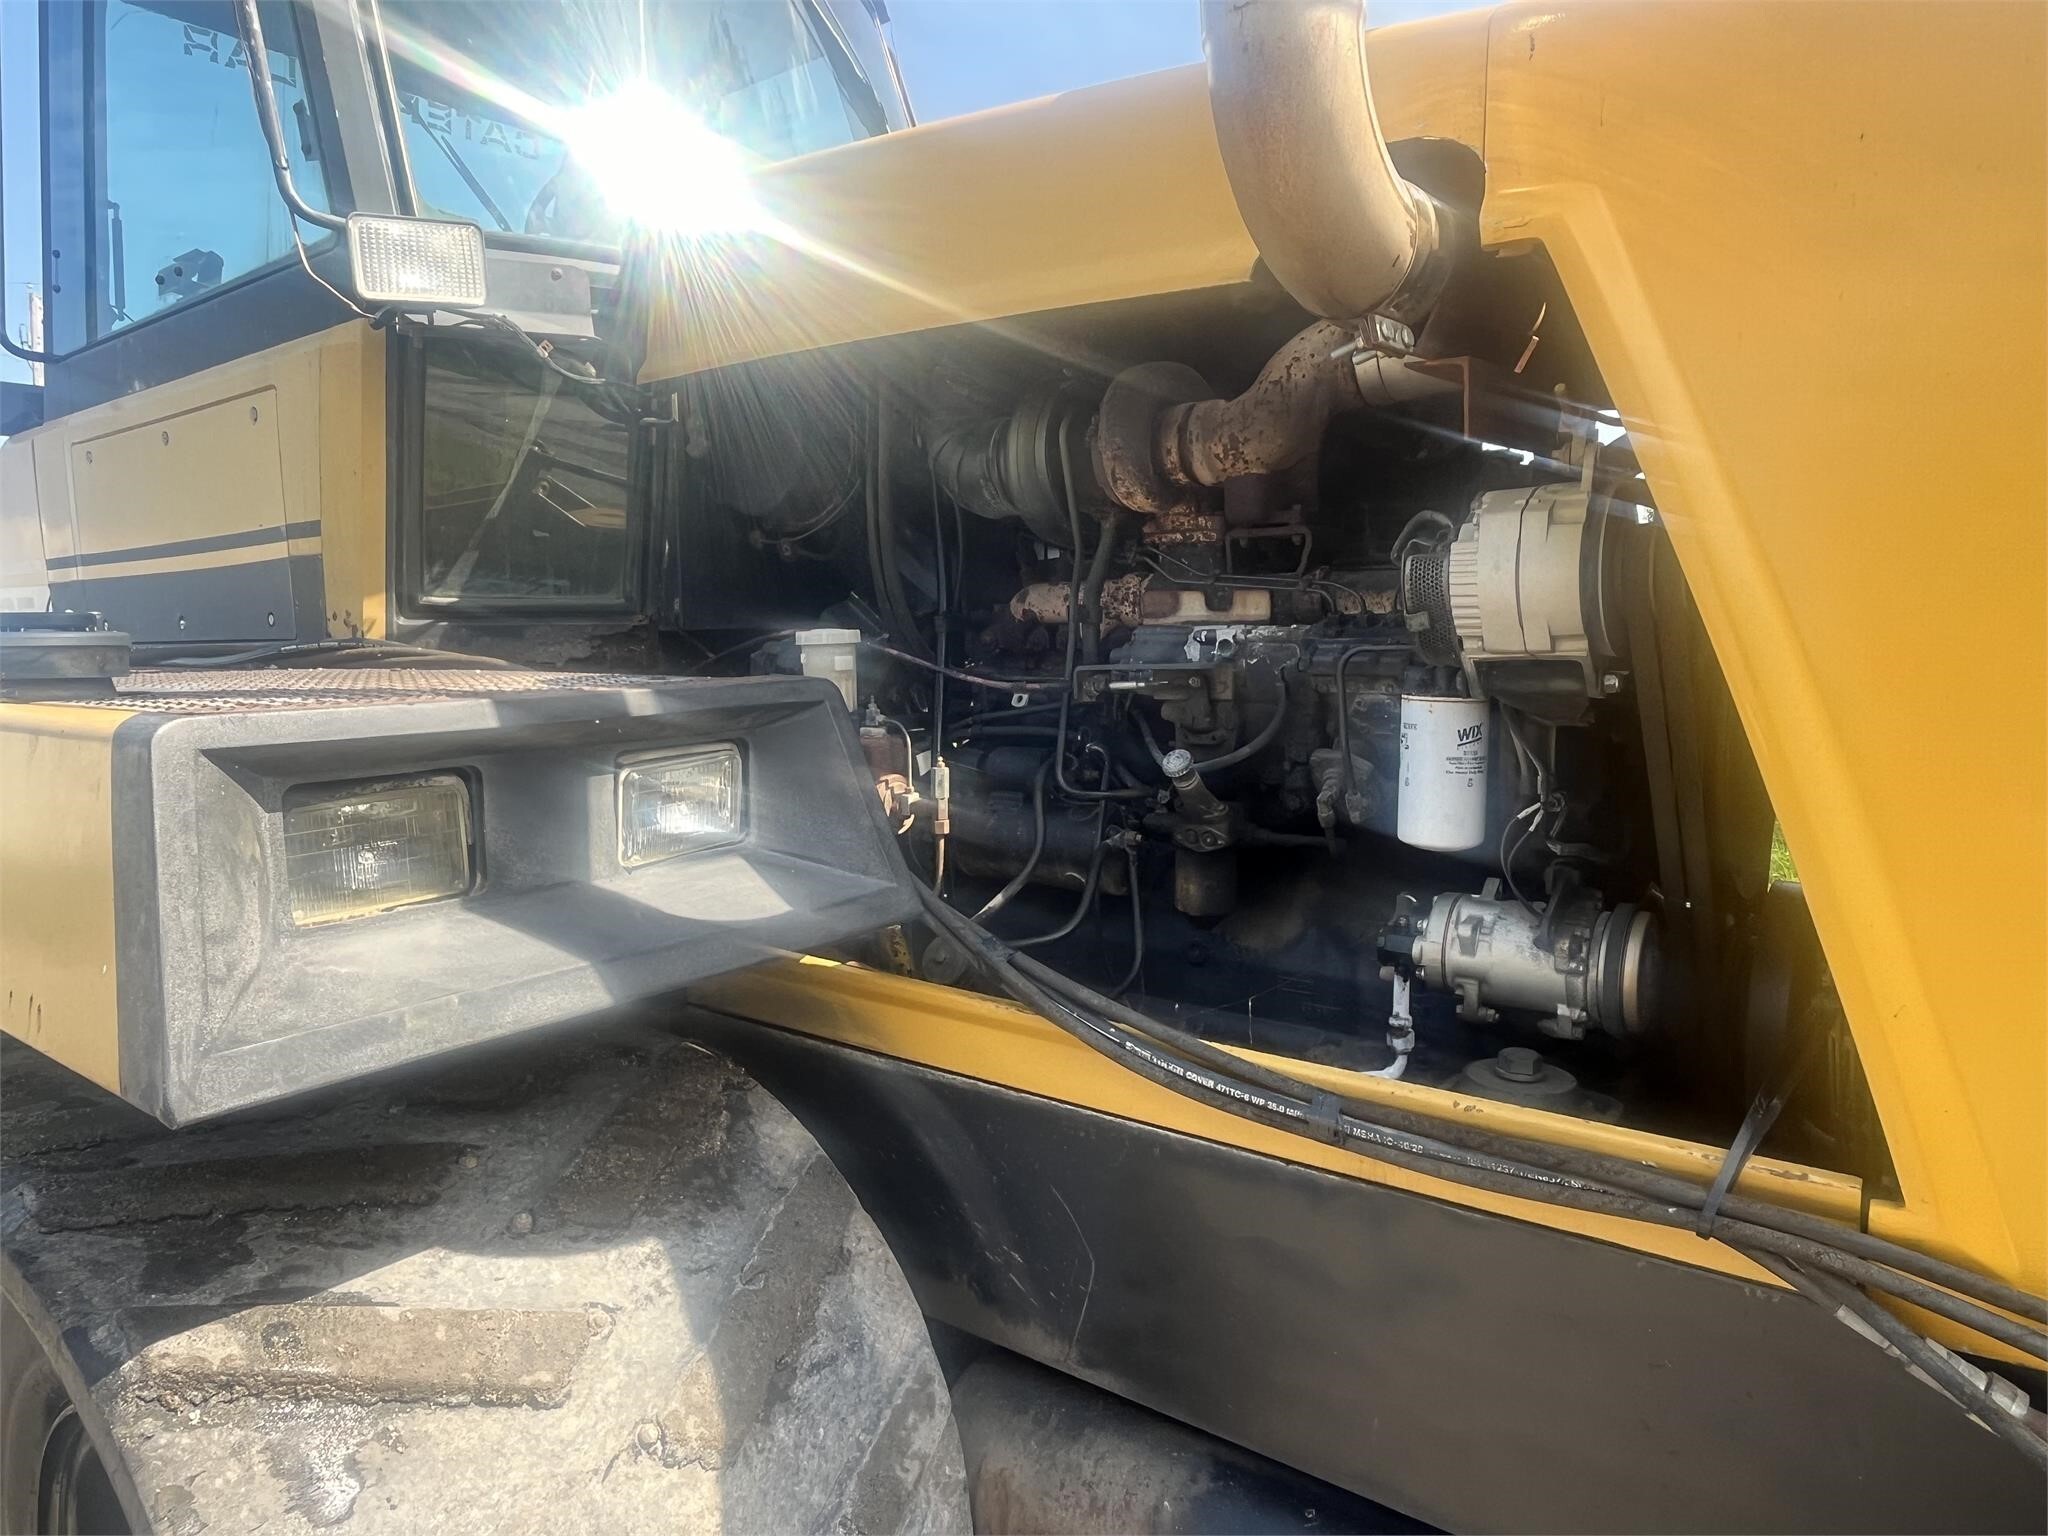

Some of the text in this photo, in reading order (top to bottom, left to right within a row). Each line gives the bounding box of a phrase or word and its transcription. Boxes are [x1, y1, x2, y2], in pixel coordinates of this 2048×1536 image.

[1457, 722, 1483, 742] WIX
[1185, 1071, 1215, 1089] COVER
[1215, 1083, 1250, 1102] 471TC-6
